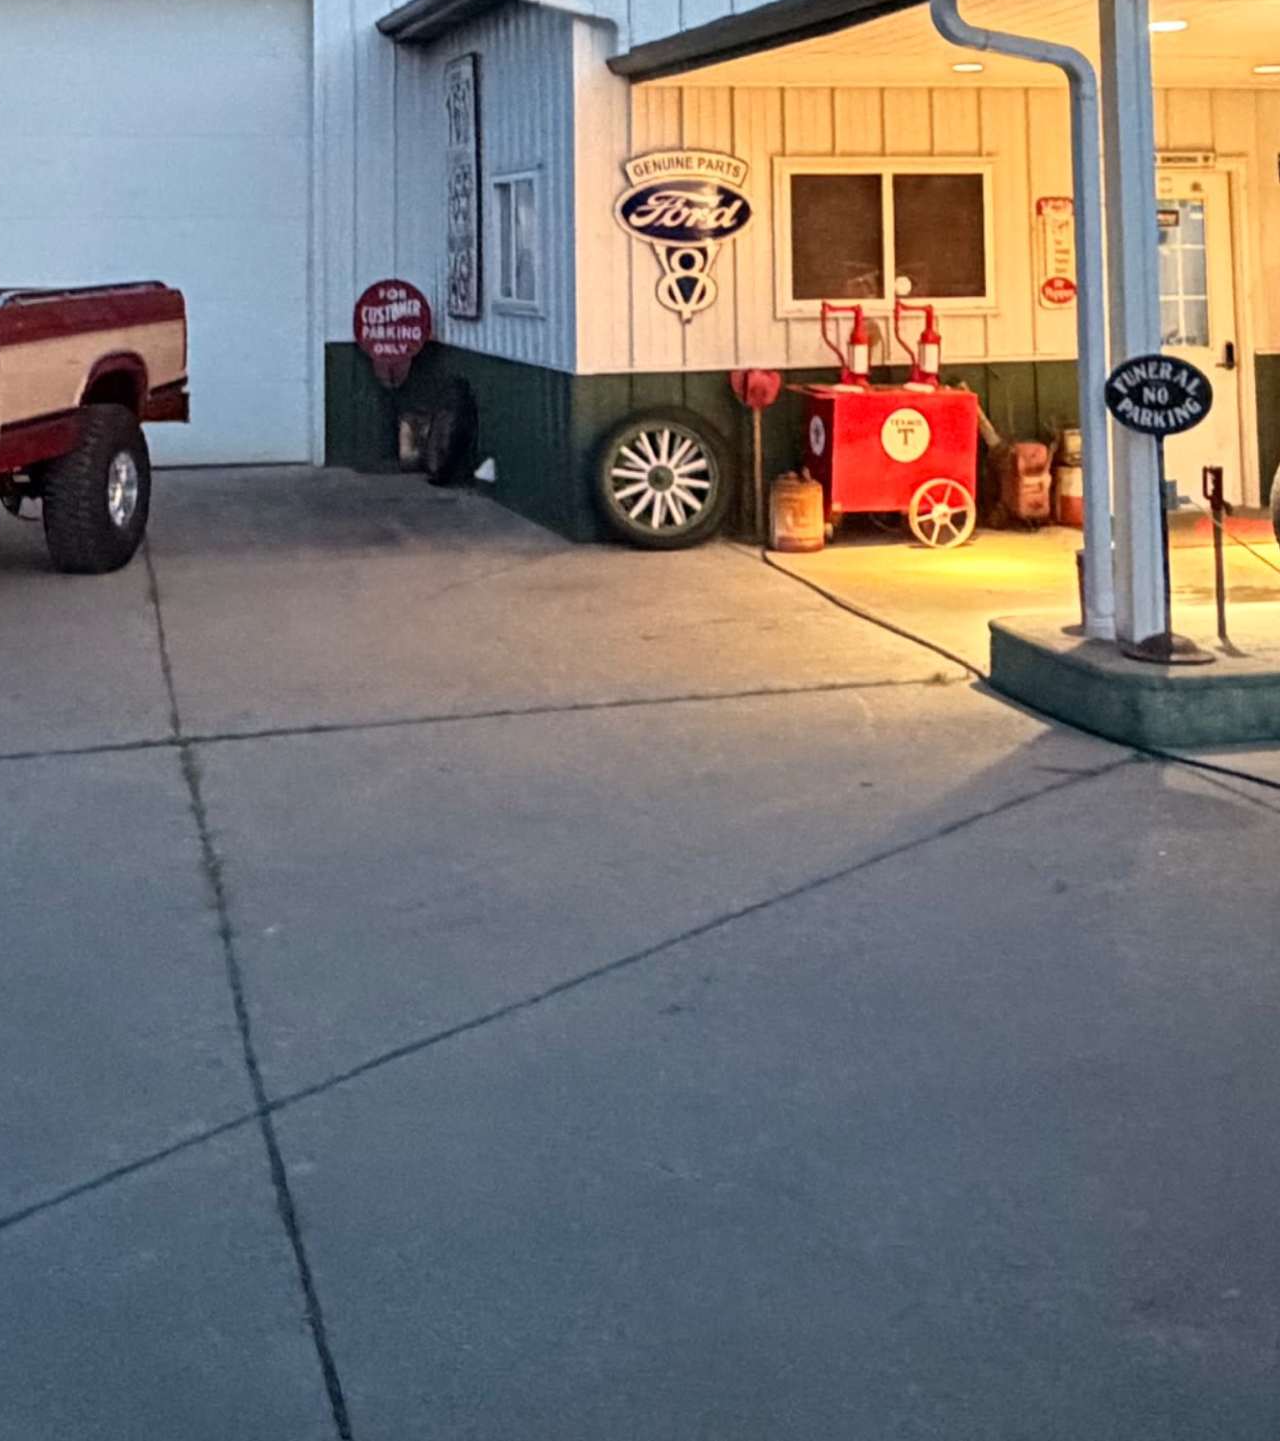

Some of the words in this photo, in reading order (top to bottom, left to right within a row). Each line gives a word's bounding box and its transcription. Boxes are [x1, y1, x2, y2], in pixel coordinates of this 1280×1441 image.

[633, 156, 694, 178] GENUINE
[697, 157, 741, 179] PARTS
[628, 190, 743, 231] Ford
[379, 288, 407, 300] FOR
[361, 299, 421, 325] CUSTOMER
[362, 325, 422, 340] PARKING
[373, 343, 408, 355] ONLY
[1113, 360, 1200, 396] FUNERAL
[1142, 386, 1169, 405] NO
[1116, 396, 1202, 429] PARKING
